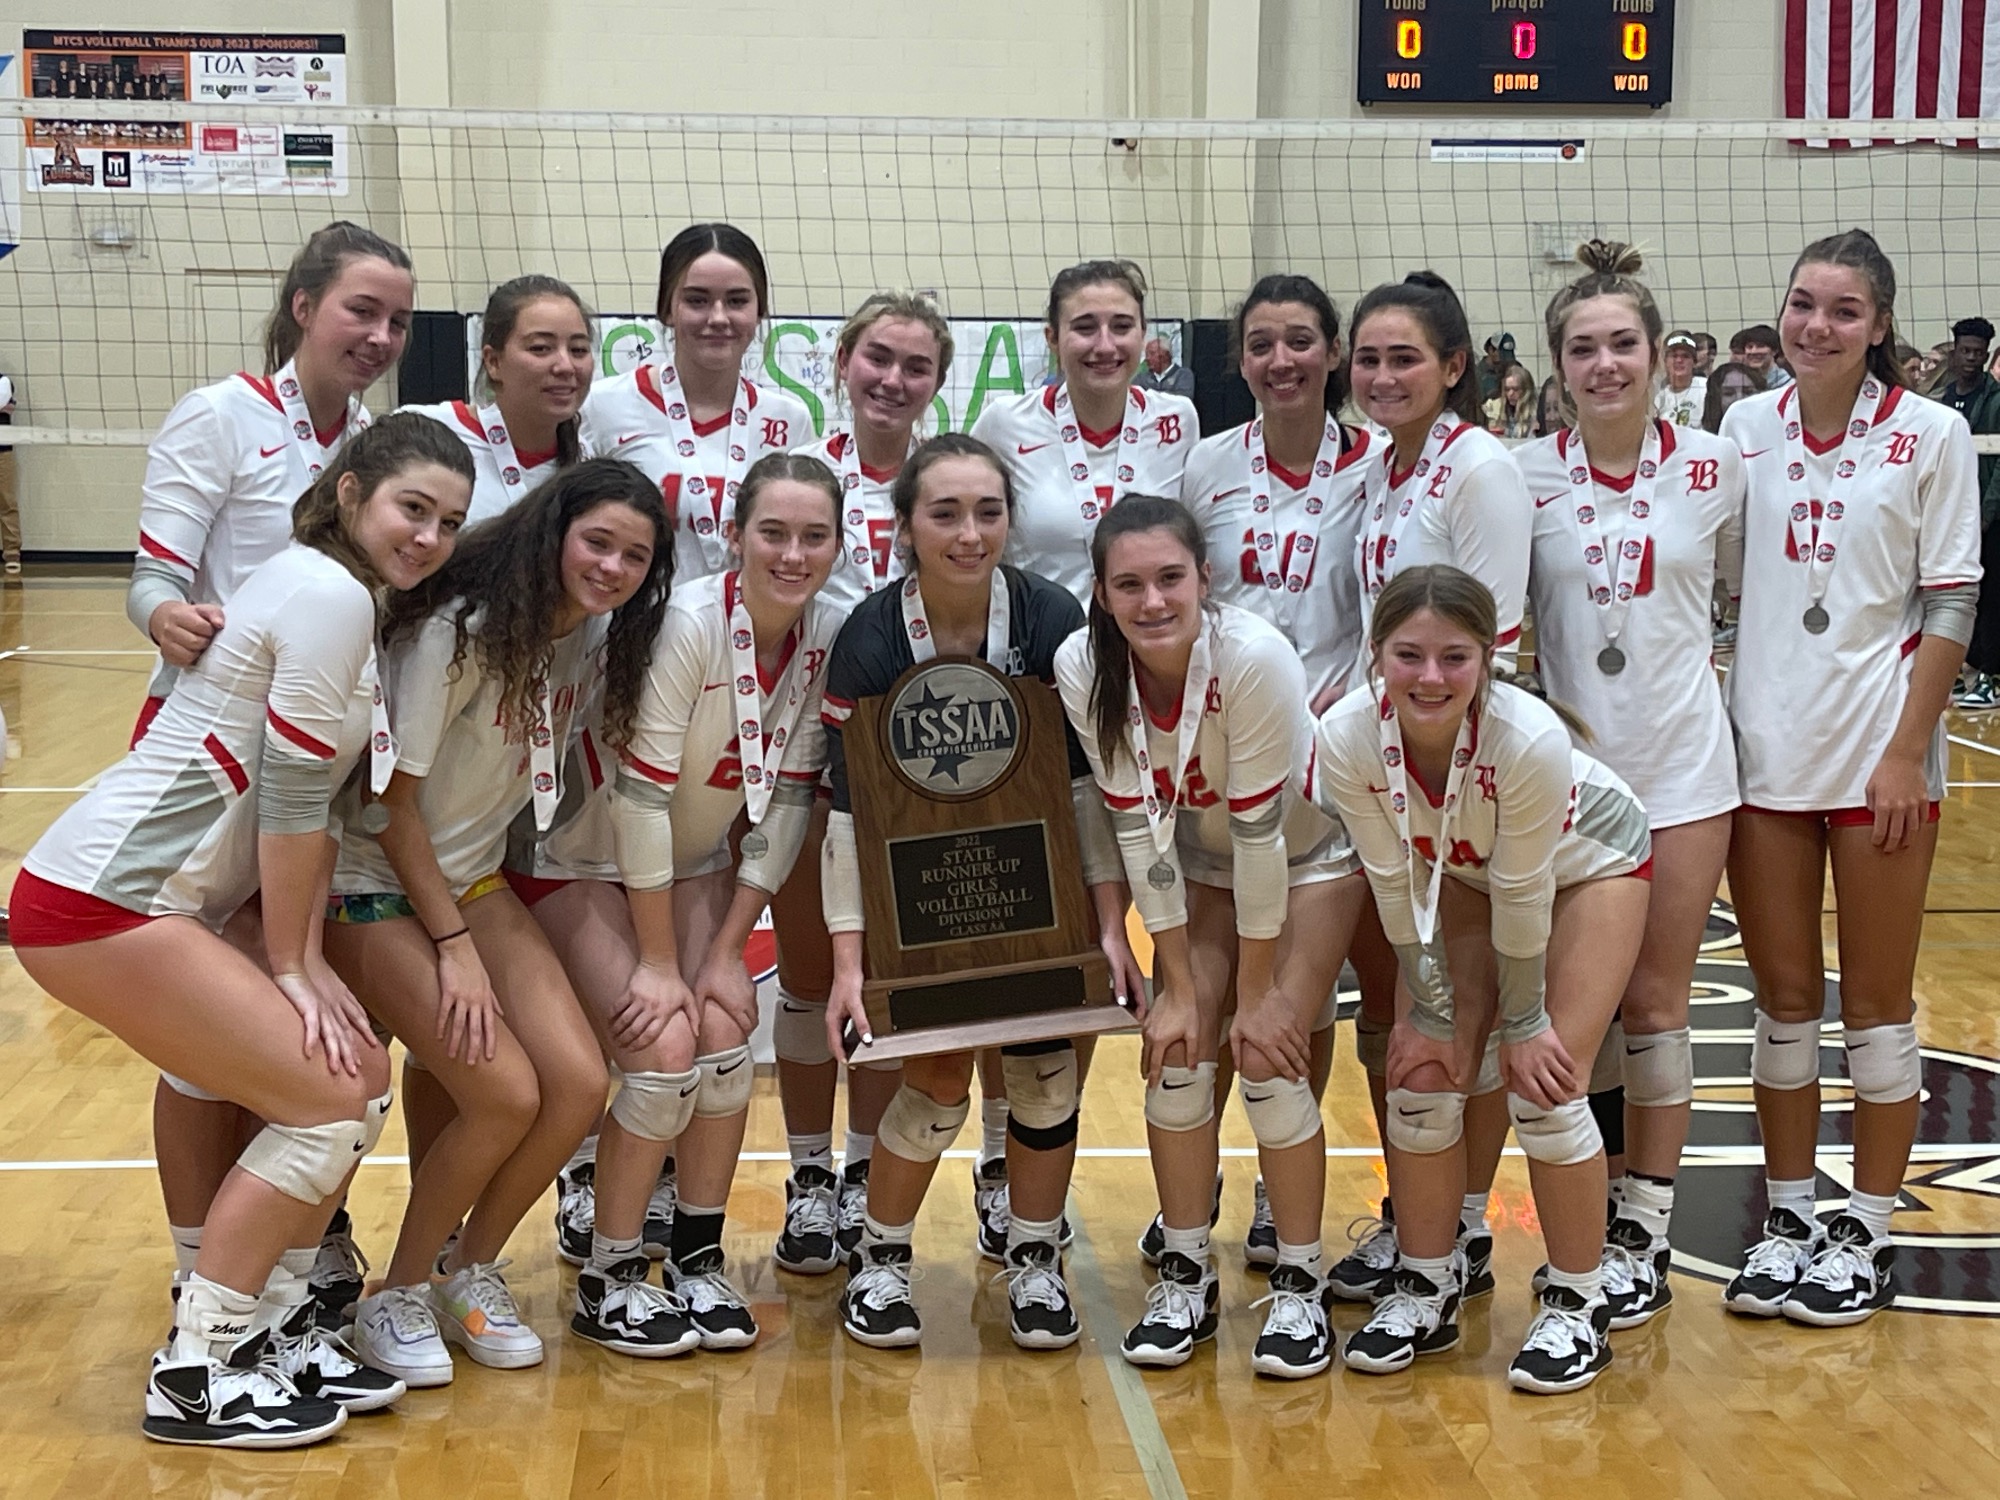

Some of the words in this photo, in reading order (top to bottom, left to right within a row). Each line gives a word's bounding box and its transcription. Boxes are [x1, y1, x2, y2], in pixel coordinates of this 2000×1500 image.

[53, 35, 83, 46] MTCS
[85, 36, 151, 47] VOLLEYBALL
[153, 37, 197, 48] THANKS
[200, 38, 223, 48] OUR
[225, 38, 250, 48] 2022
[1396, 20, 1422, 59] 0
[1511, 21, 1537, 59] 0
[1622, 22, 1648, 61] 0
[199, 55, 245, 74] TOA
[1386, 72, 1421, 89] won
[1493, 73, 1539, 94] game
[1613, 74, 1649, 91] won
[760, 417, 788, 449] B
[1880, 431, 1918, 468] B
[1685, 459, 1719, 496] B
[896, 700, 1011, 751] TSSAA
[917, 741, 996, 758] CHAMPIONSHIPS
[955, 835, 981, 848] 2022
[943, 845, 997, 866] STATE
[921, 858, 1021, 884] RUNNER-UP
[947, 877, 999, 897] GIRLS
[916, 887, 1033, 915] VOLLEYBALL
[938, 907, 1000, 926] DIVISION
[1004, 905, 1015, 918] II
[950, 923, 987, 937] CLASS
[988, 921, 1006, 933] AA
